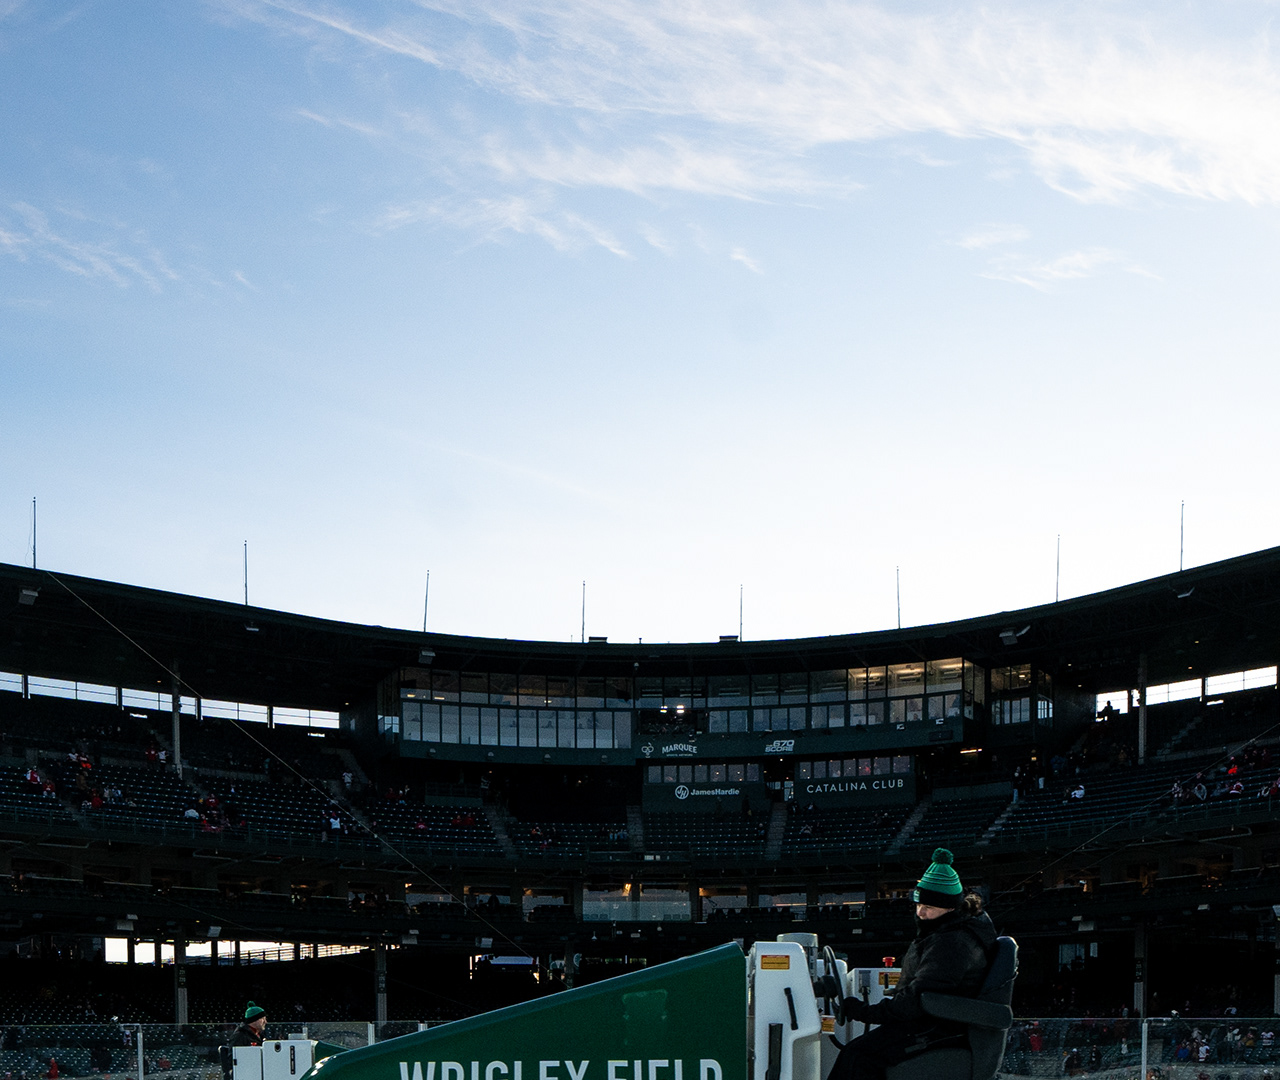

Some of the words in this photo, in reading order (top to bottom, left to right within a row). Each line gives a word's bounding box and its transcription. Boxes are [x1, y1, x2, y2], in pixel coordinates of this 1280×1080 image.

[772, 739, 795, 747] 670
[661, 743, 698, 755] MARQUEE
[806, 781, 867, 794] CATALINA
[872, 778, 904, 790] CLUB
[690, 787, 740, 797] JamesHardie
